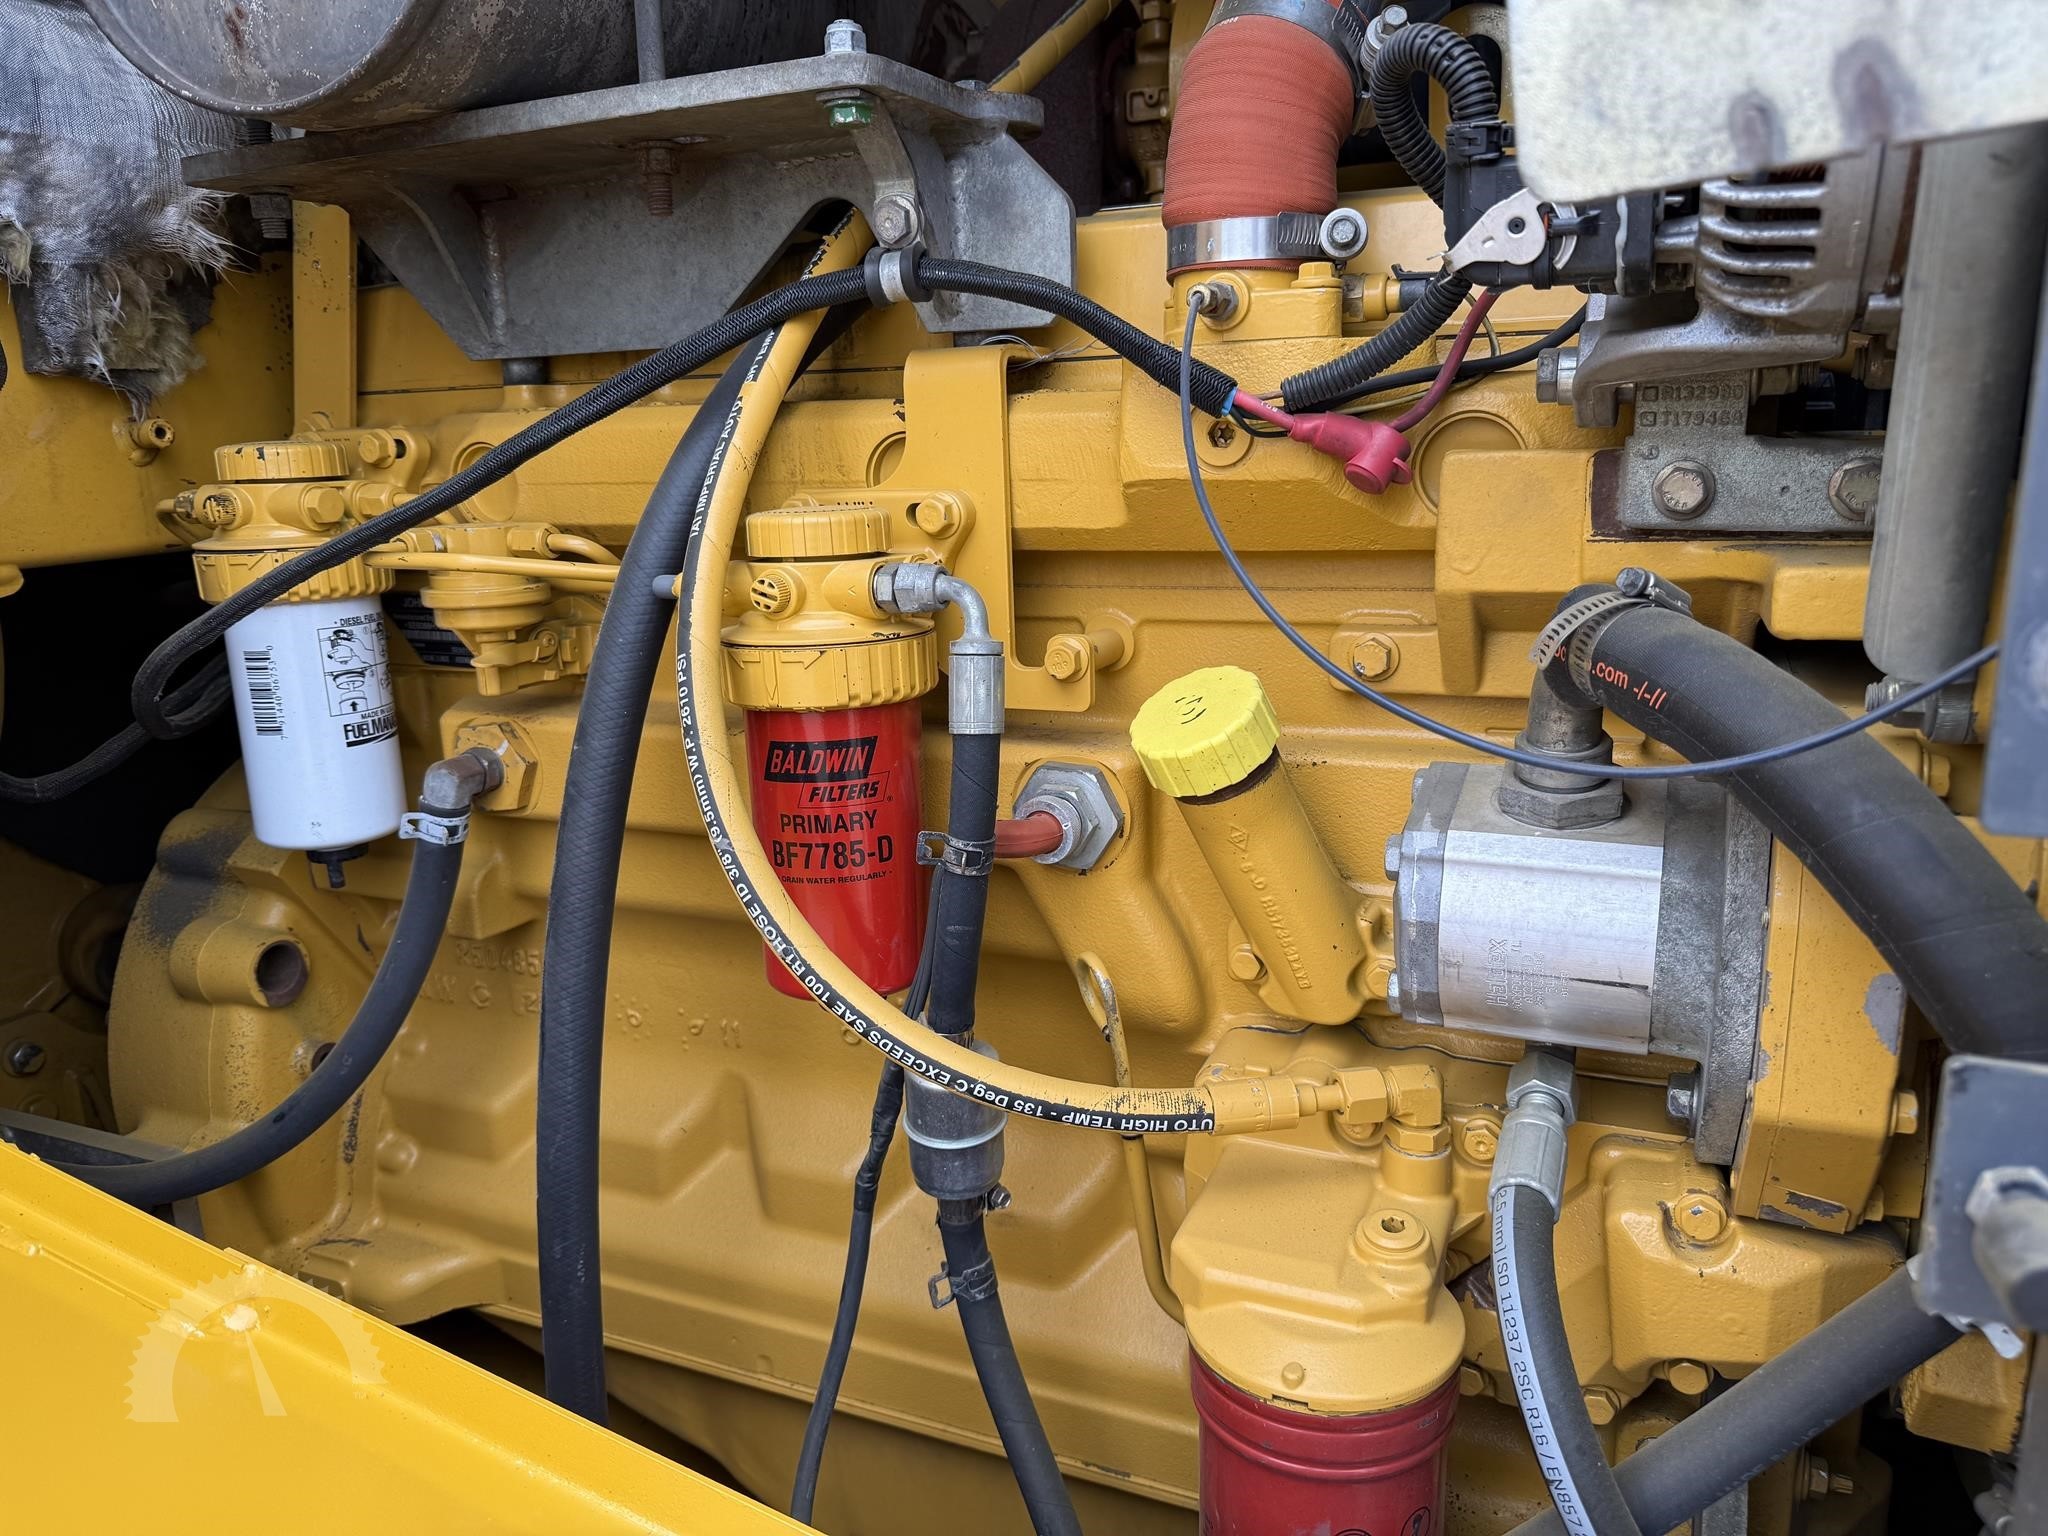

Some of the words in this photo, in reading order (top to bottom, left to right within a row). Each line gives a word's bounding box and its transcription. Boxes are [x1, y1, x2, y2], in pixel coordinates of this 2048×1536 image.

[698, 440, 726, 510] IMPERIAL
[340, 616, 363, 627] DIESEL
[676, 653, 688, 684] PSI
[678, 686, 693, 729] 2610
[769, 745, 870, 775] BALDWIN
[808, 781, 881, 803] FILTERS
[692, 773, 724, 844] (9.5mm)
[780, 809, 878, 834] PRIMARY
[717, 849, 740, 882] 3/8"
[772, 834, 894, 870] BF7785-D
[782, 875, 804, 885] DRAIN
[806, 876, 836, 885] WATER
[837, 871, 887, 884] REGULARLY
[735, 883, 753, 906] ID
[747, 902, 787, 959] HOSE
[804, 975, 831, 1003] 100
[831, 1000, 867, 1034] SAE
[867, 1030, 952, 1086] EXCEEDS
[954, 1079, 1009, 1109] Deg.C
[1013, 1099, 1044, 1117] 135
[1061, 1113, 1115, 1130] TEMP
[1121, 1120, 1168, 1132] HIGH
[1496, 1256, 1511, 1288] ISO
[1500, 1293, 1524, 1354] 11237
[1513, 1361, 1534, 1401] 2SC
[1526, 1407, 1550, 1447] R16
[1546, 1466, 1584, 1528] EN857
